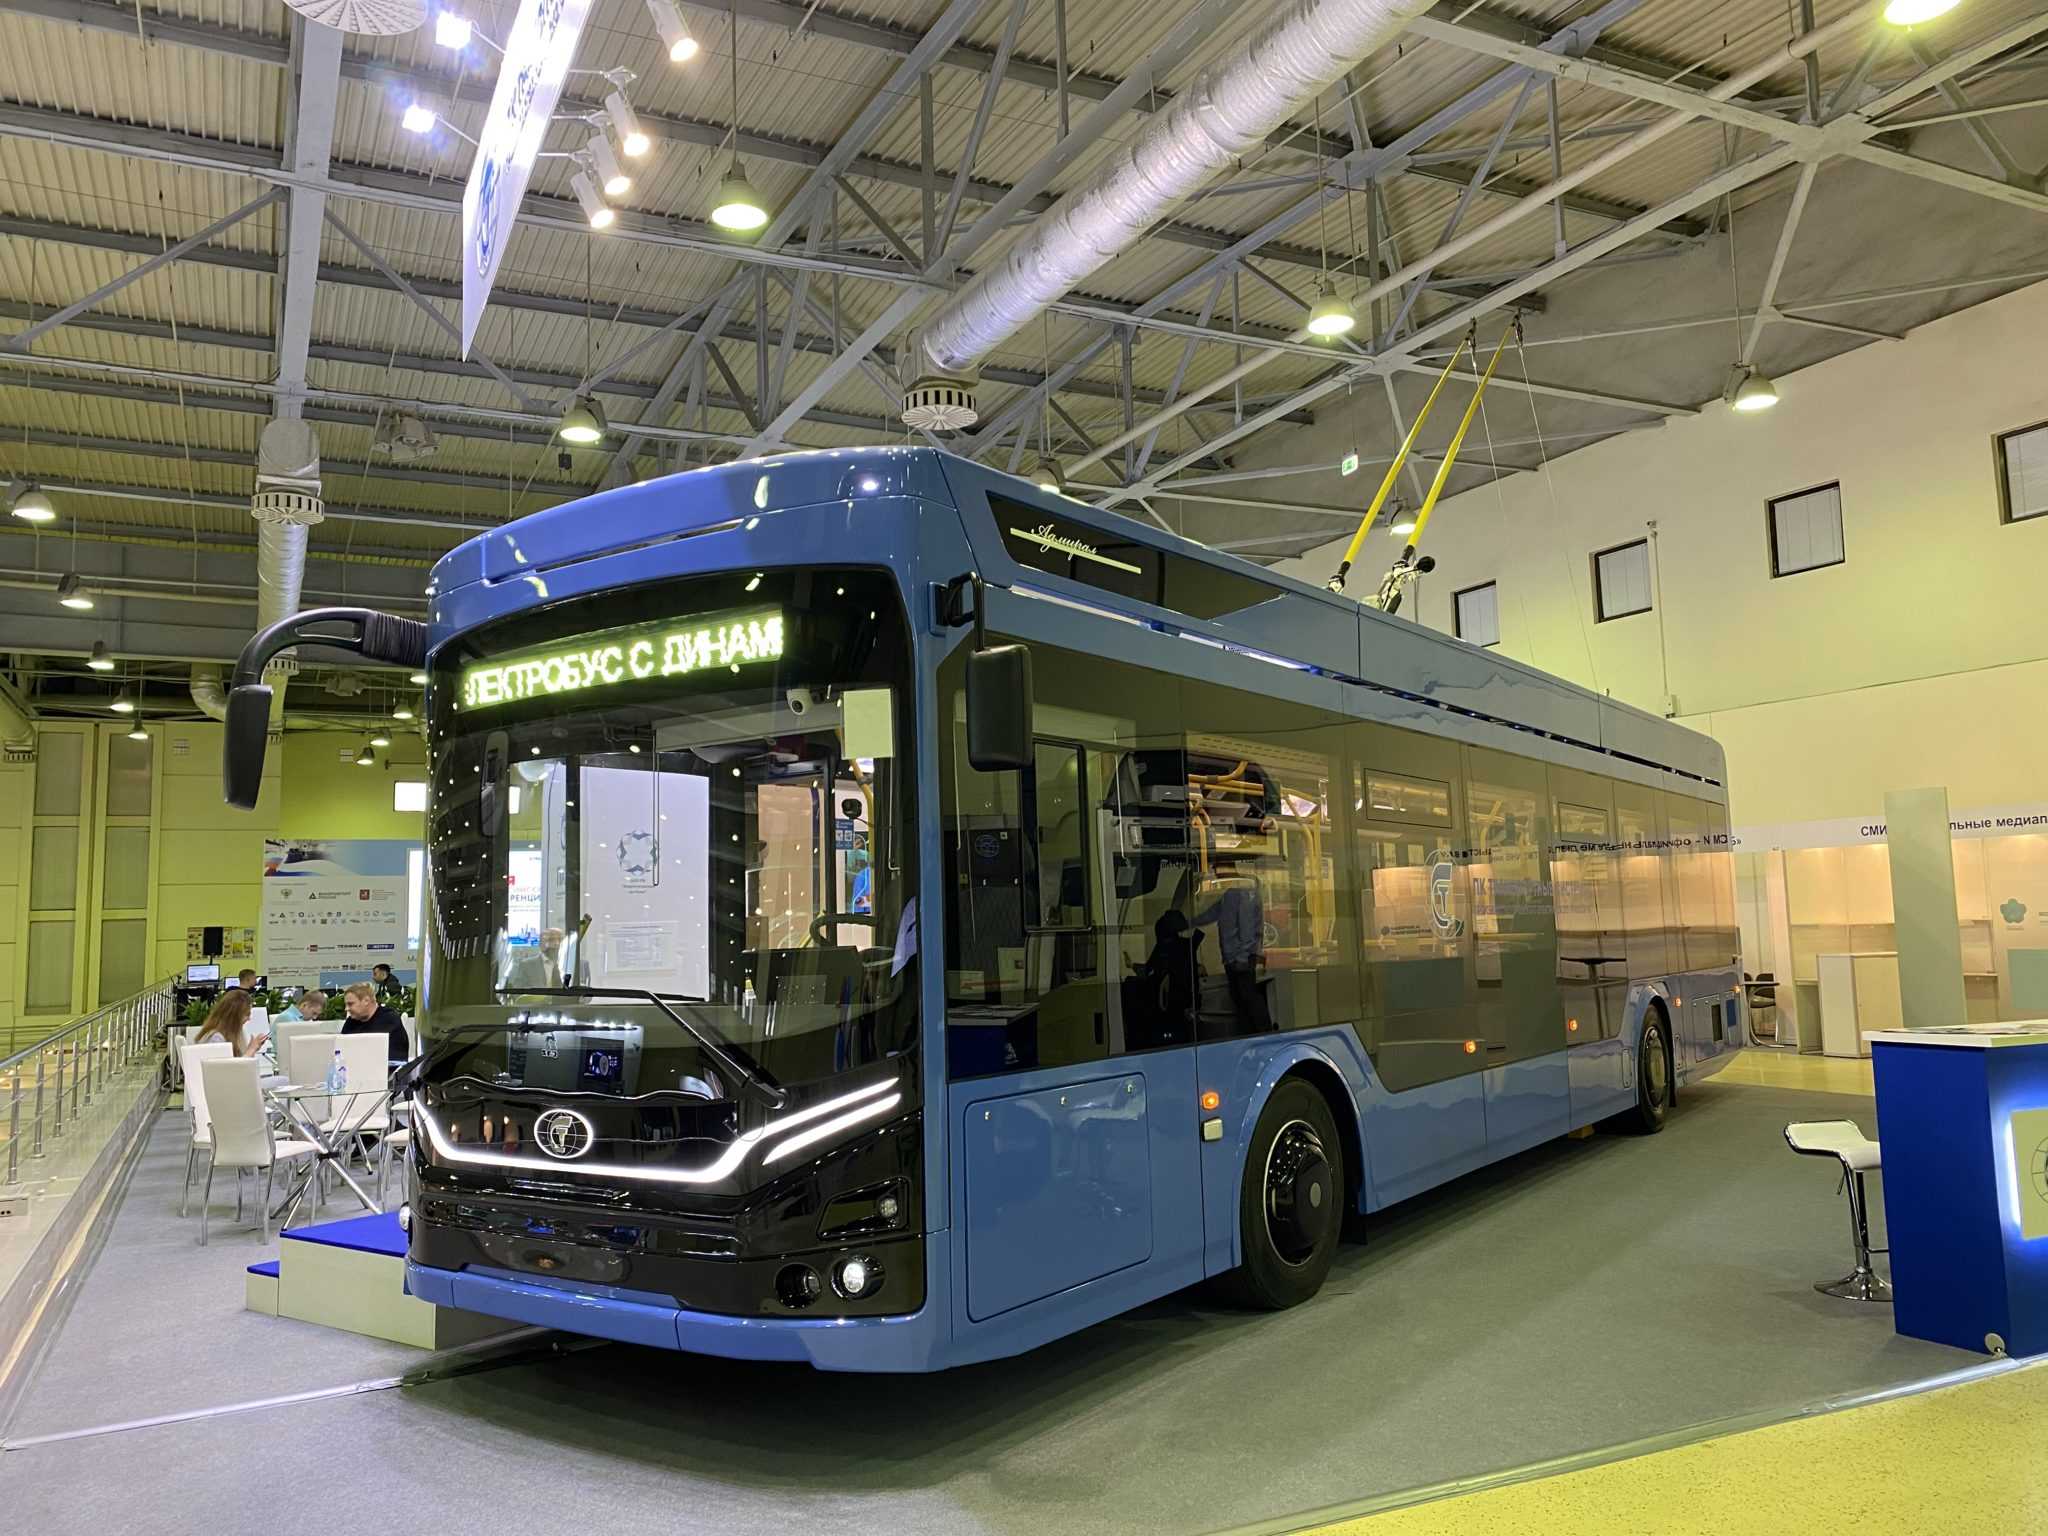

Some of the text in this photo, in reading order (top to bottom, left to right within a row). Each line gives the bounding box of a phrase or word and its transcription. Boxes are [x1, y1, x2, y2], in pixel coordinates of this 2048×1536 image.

[464, 645, 624, 706] ЛЕКТРОБУС
[629, 640, 655, 679] С
[1860, 824, 1889, 837] СМИ
[1948, 818, 1993, 831] льные
